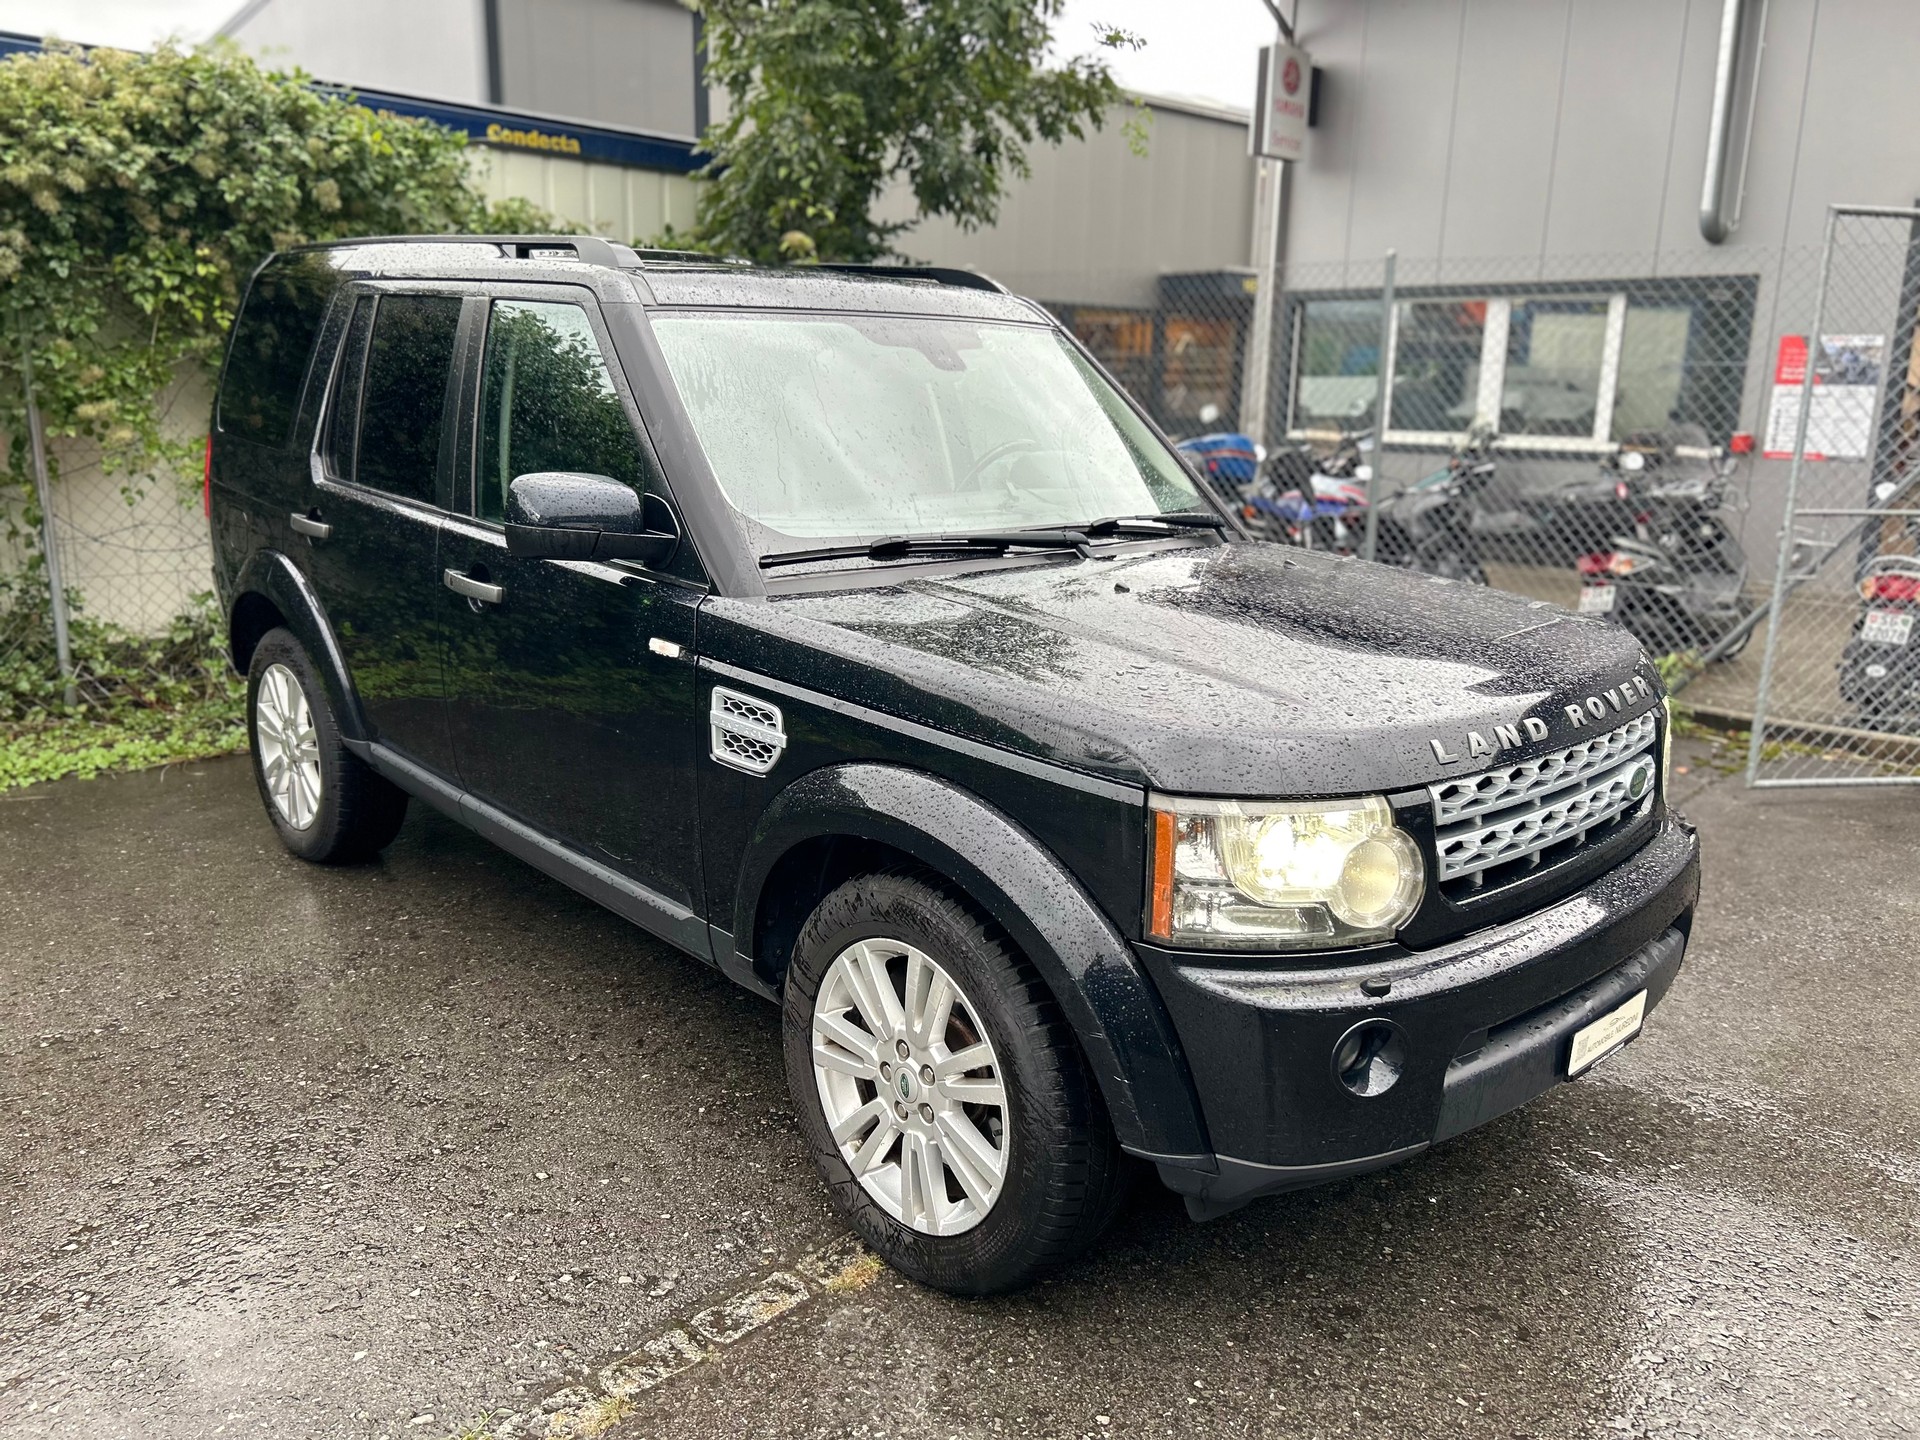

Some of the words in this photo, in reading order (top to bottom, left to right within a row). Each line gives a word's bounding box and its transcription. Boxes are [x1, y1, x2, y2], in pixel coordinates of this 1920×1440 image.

[486, 123, 581, 154] Condecta
[1429, 716, 1549, 765] LAND
[1564, 675, 1650, 729] ROVER
